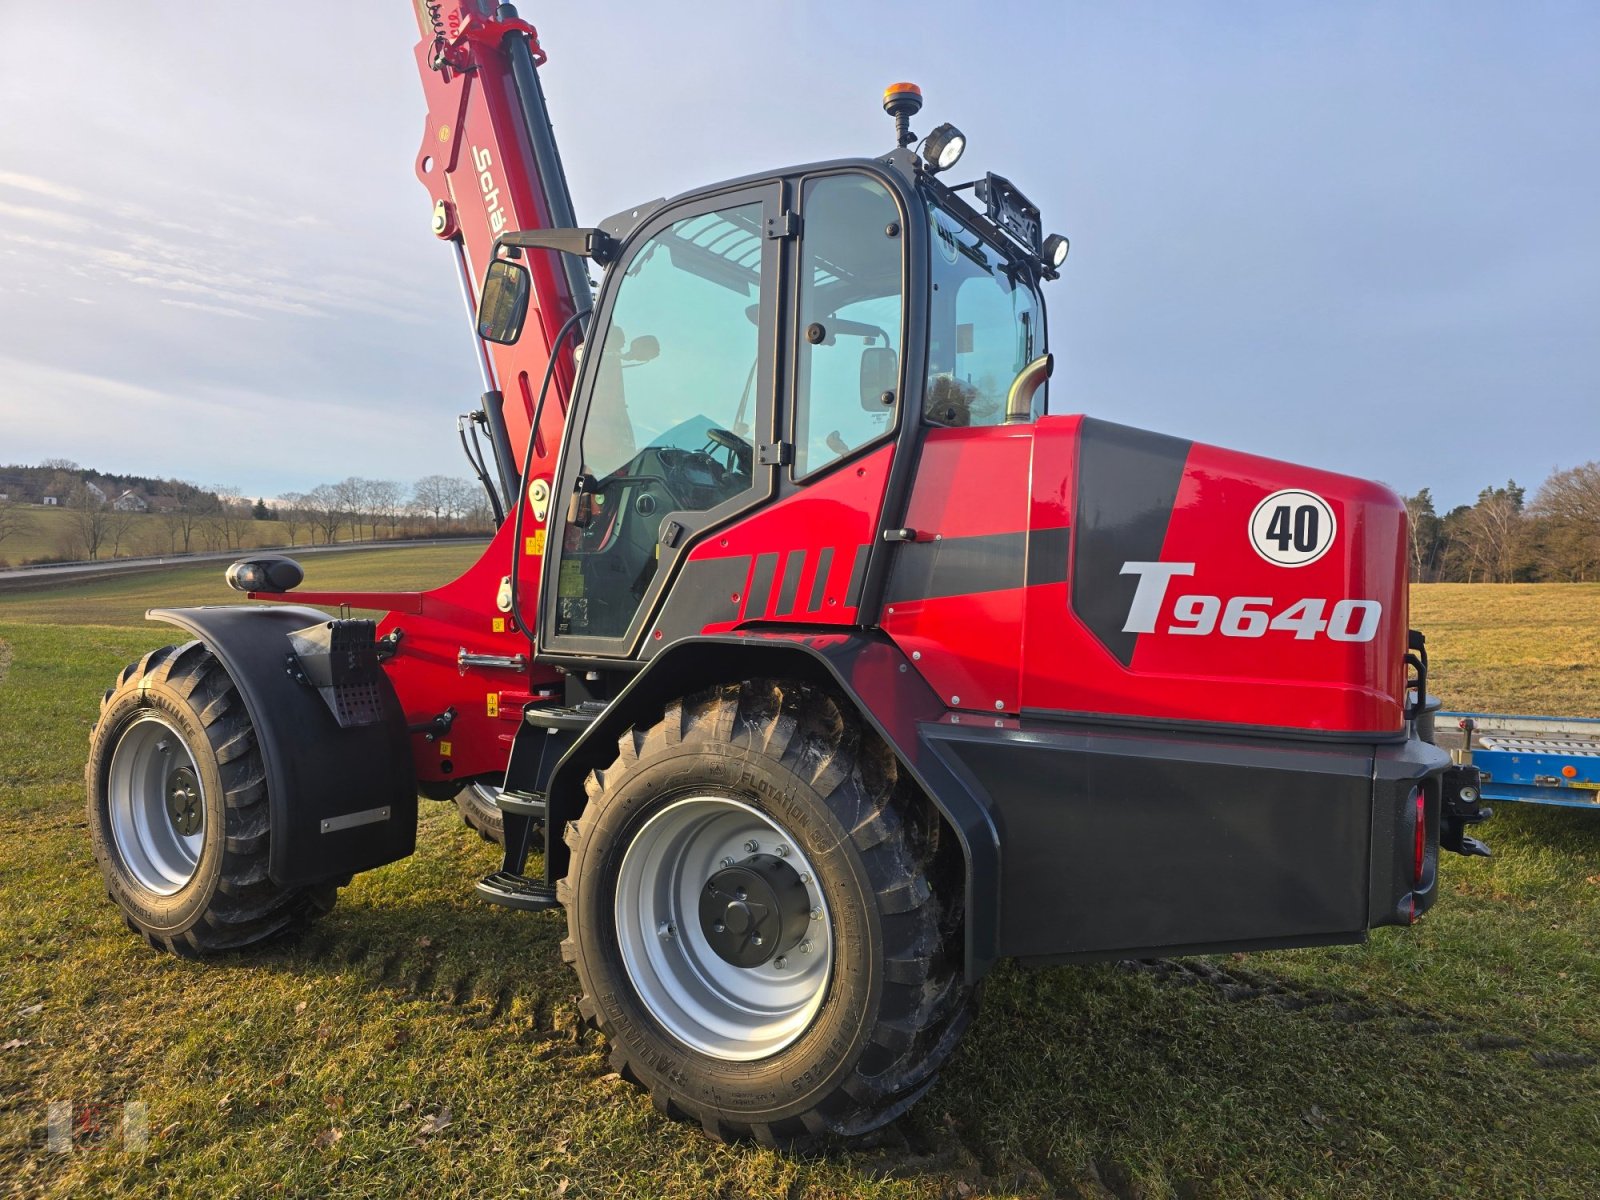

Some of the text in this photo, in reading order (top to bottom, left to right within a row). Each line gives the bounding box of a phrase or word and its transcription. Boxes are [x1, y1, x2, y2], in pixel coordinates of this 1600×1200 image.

[1266, 504, 1319, 552] 40
[741, 771, 812, 828] FLOTATION
[601, 990, 676, 1075] ALLIANCE
